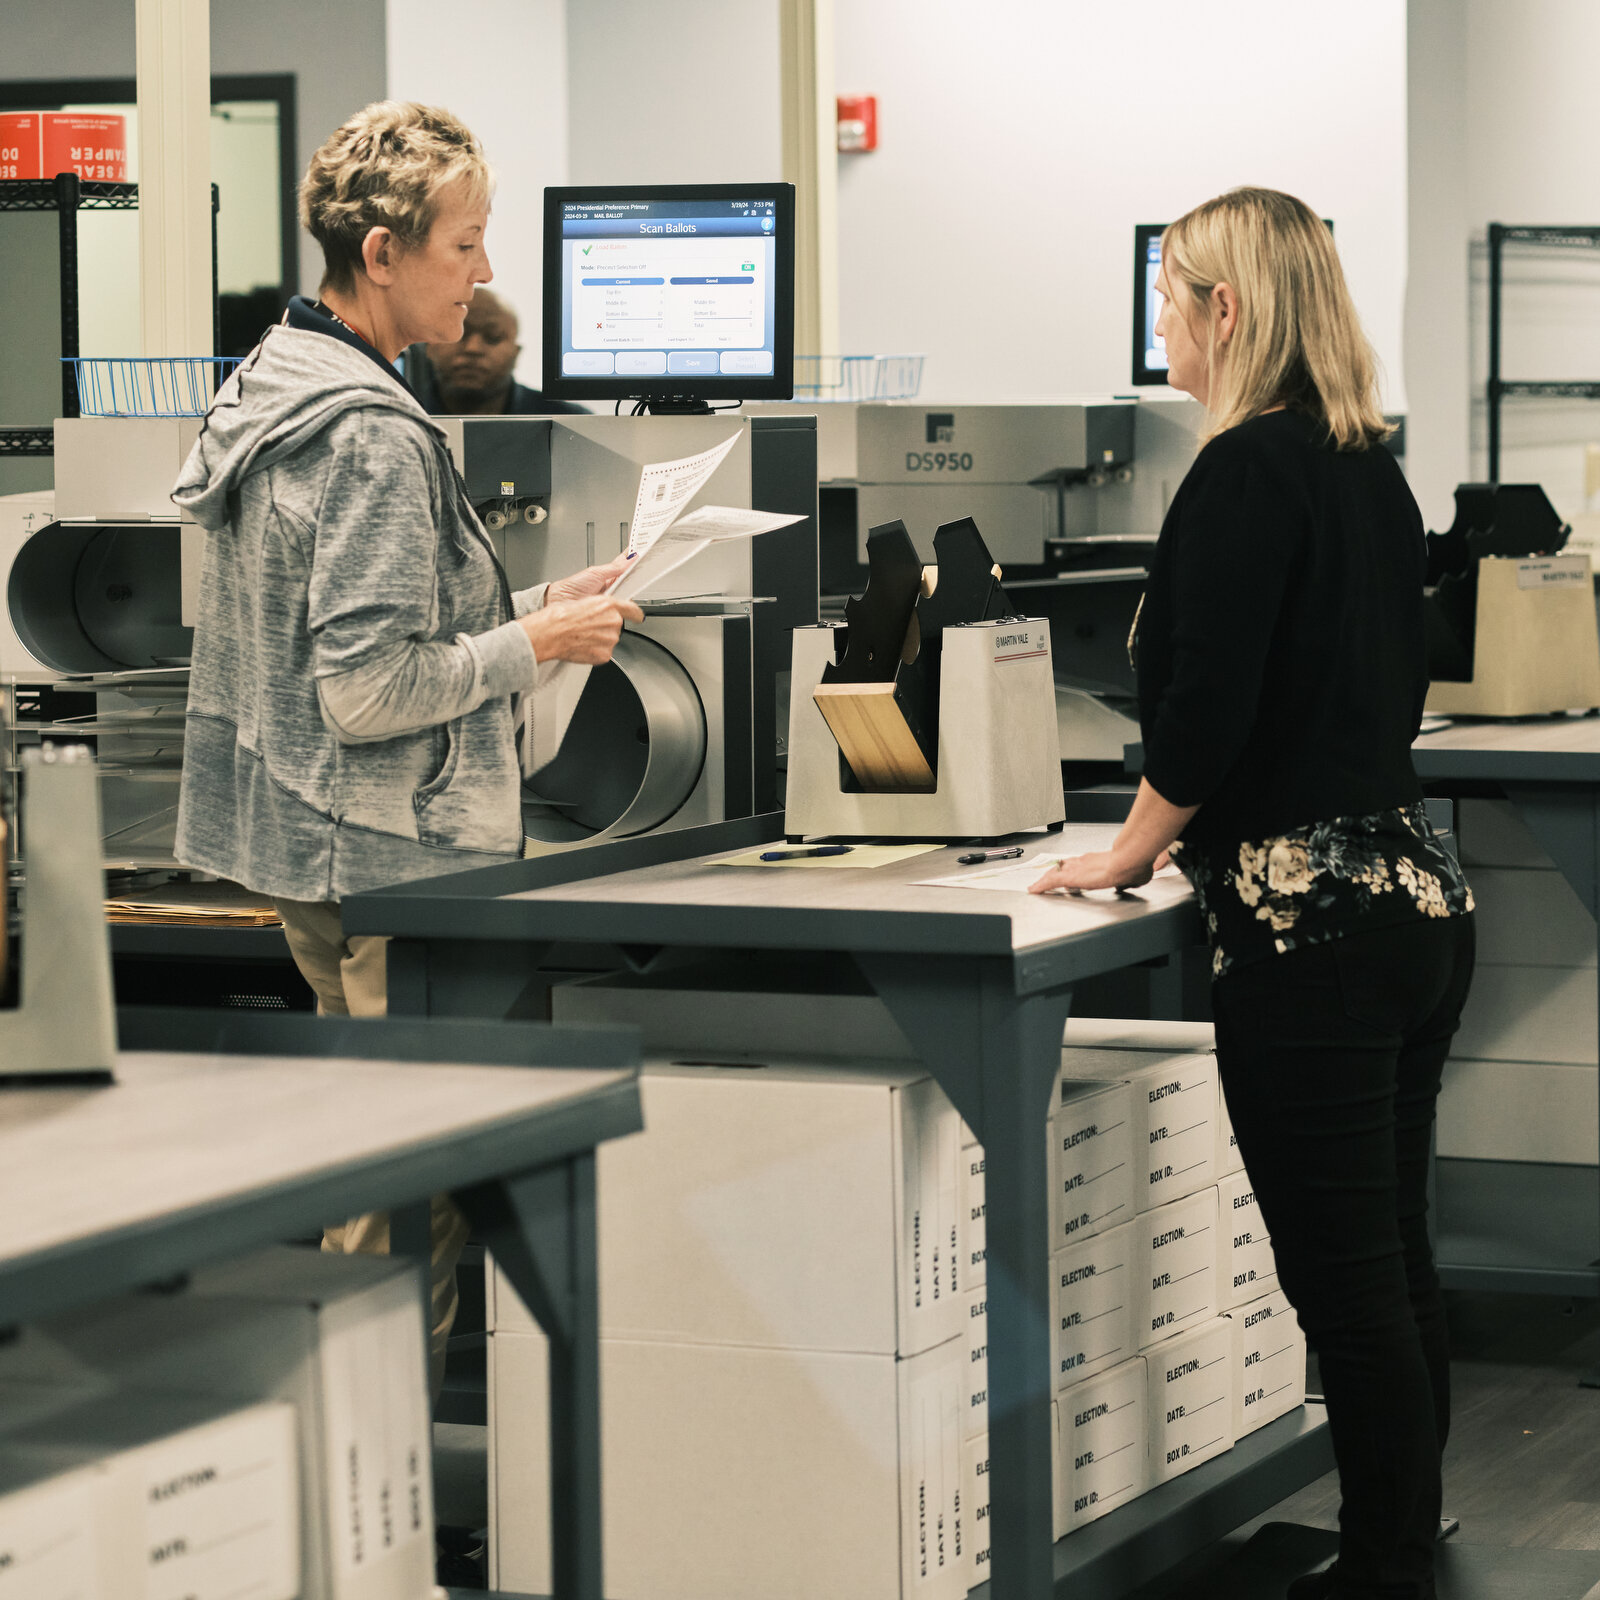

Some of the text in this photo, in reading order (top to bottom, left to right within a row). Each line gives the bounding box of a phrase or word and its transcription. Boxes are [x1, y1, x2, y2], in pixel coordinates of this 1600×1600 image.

[72, 164, 114, 179] SEAL
[639, 222, 697, 234] Scan Ballots
[905, 452, 974, 472] DS950
[1000, 635, 1018, 647] MARTIN
[1149, 1080, 1182, 1103] ELECTION:
[1063, 1124, 1098, 1151] ELECTION:
[1149, 1126, 1169, 1144] DATE:
[1064, 1173, 1085, 1193] DATE:
[1149, 1165, 1173, 1184] BOX ID:
[1065, 1213, 1090, 1235] BOX ID:
[1152, 1226, 1185, 1250] ELECTION:
[1233, 1232, 1252, 1249] DATE:
[1061, 1264, 1097, 1288] ELECTION:
[1152, 1273, 1171, 1290] DATE:
[1233, 1270, 1257, 1288] BOX ID:
[1061, 1312, 1082, 1331] DATE:
[1152, 1312, 1175, 1331] BOX ID:
[1244, 1306, 1273, 1329] ELECTION:
[1061, 1352, 1086, 1373] BOX ID:
[1244, 1351, 1261, 1368] DATE:
[1166, 1358, 1200, 1383] ELECTION:
[1244, 1387, 1265, 1407] BOX ID:
[1075, 1402, 1109, 1428] ELECTION:
[1166, 1405, 1186, 1424] DATE:
[1075, 1451, 1094, 1470] DATE:
[1166, 1443, 1191, 1465] BOX ID:
[1074, 1491, 1099, 1513] BOX ID:
